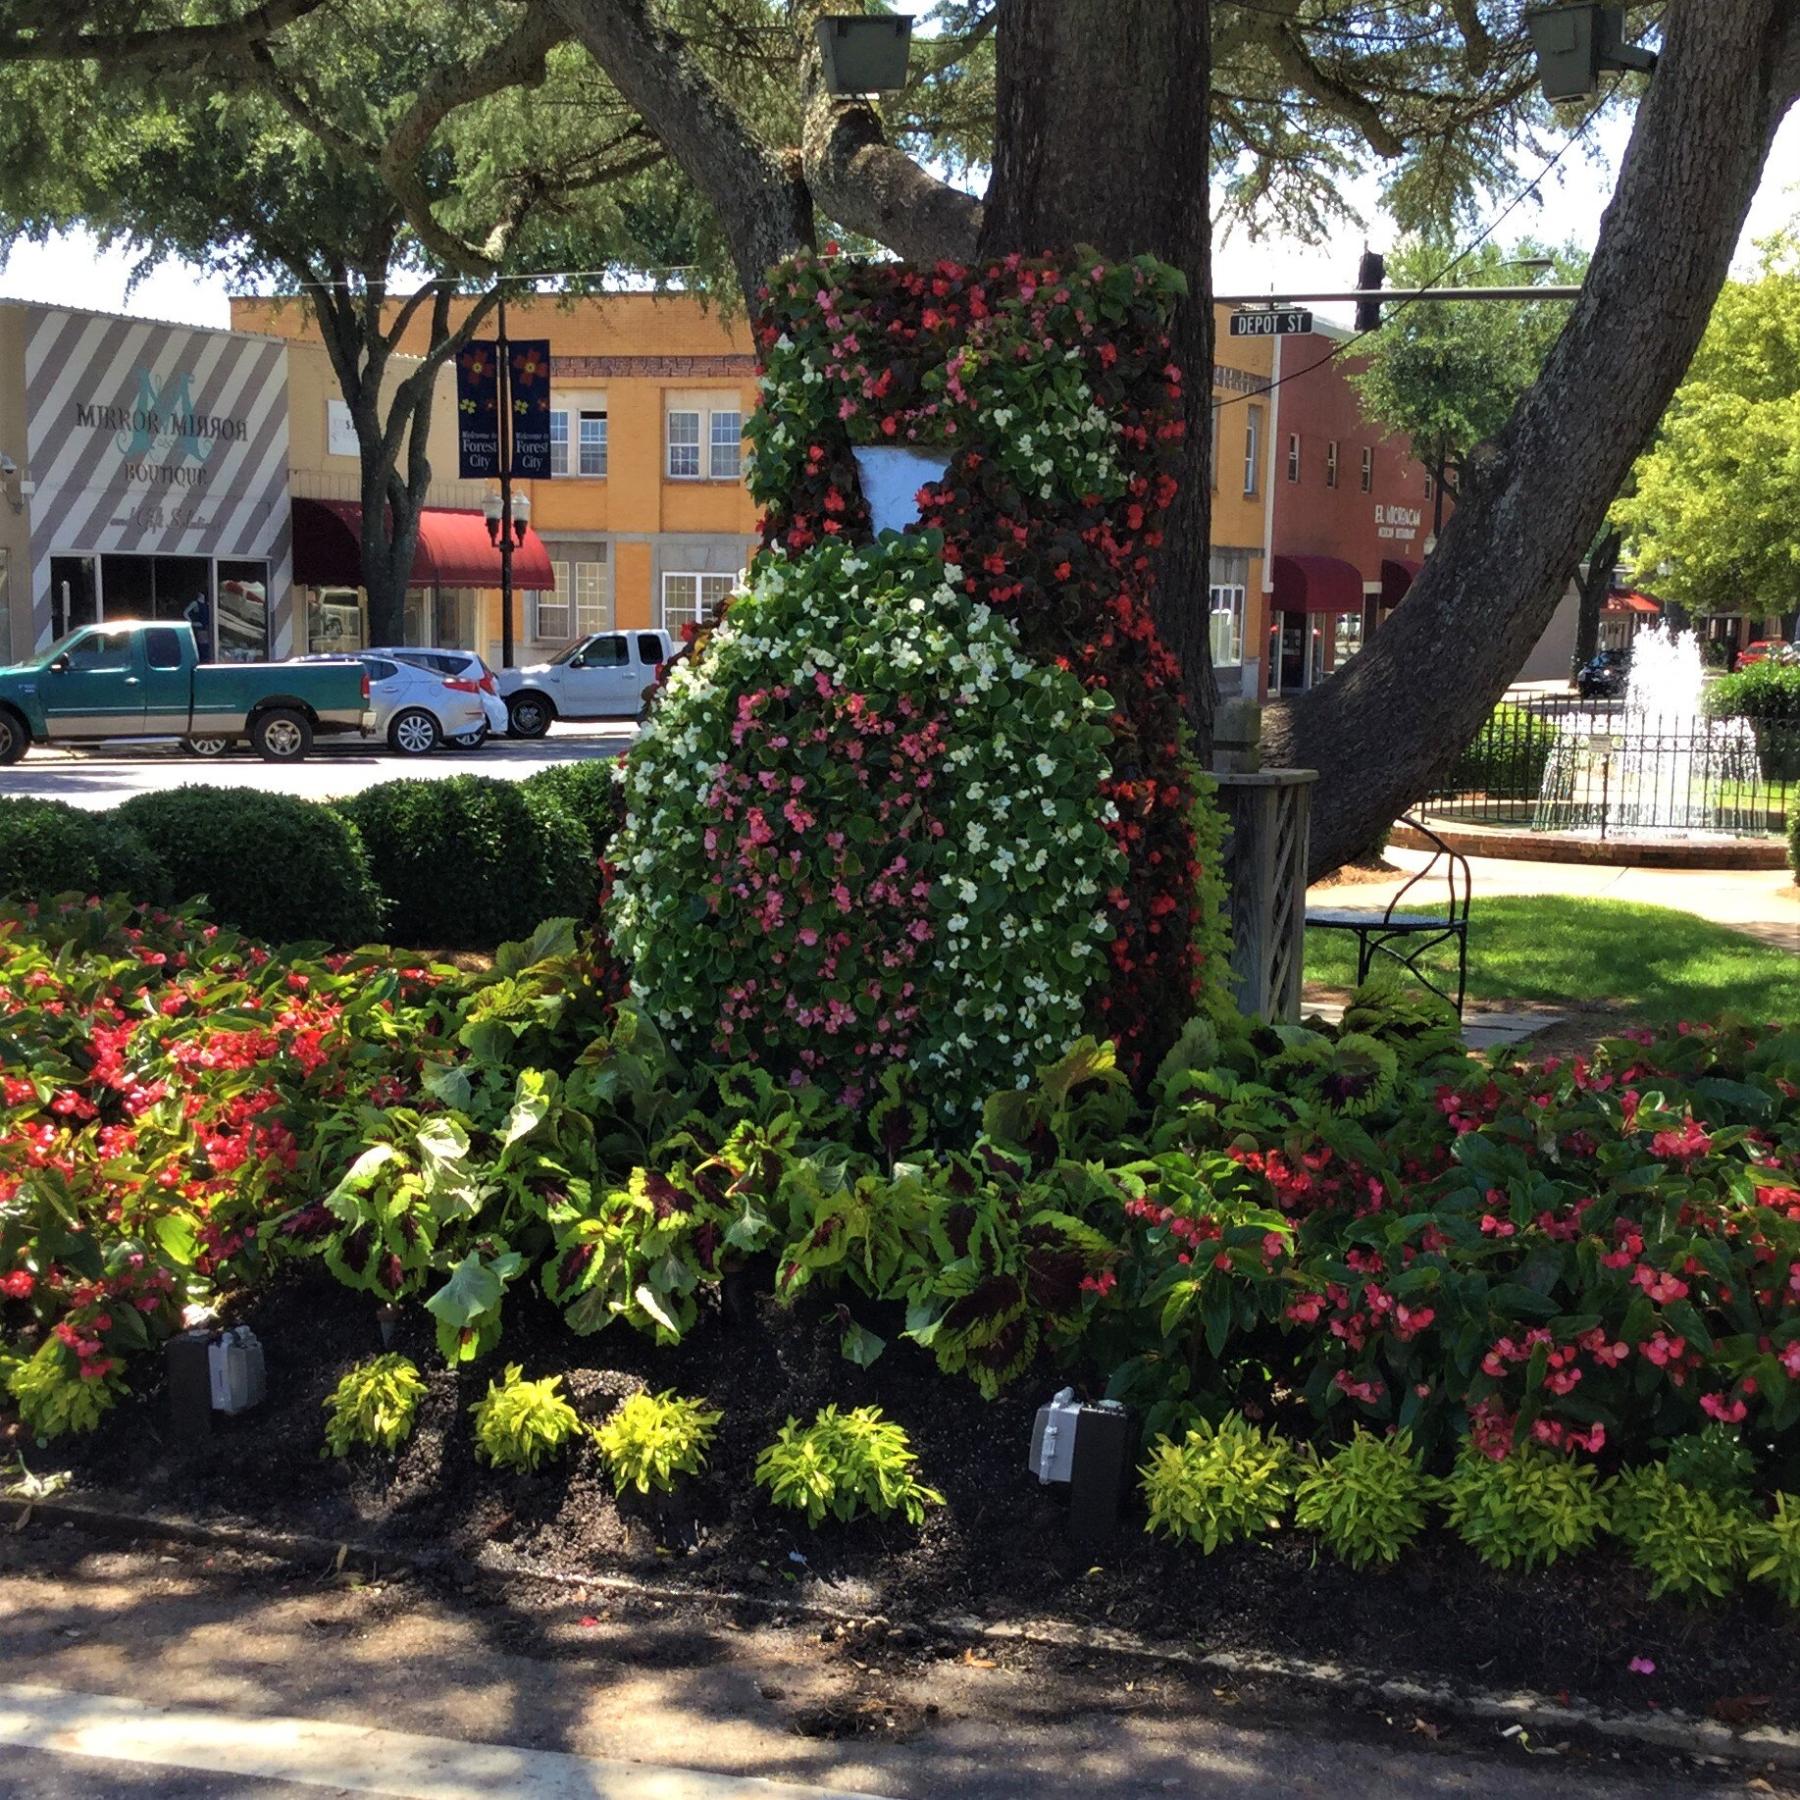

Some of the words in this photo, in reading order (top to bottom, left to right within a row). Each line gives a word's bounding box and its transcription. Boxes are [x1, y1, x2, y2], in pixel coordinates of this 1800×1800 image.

[1238, 316, 1279, 334] DEPOT
[1287, 314, 1303, 332] ST
[463, 440, 497, 453] Forest
[516, 440, 549, 454] Forest
[470, 454, 490, 470] City
[523, 455, 543, 471] City
[125, 463, 208, 488] BOUTIQUE
